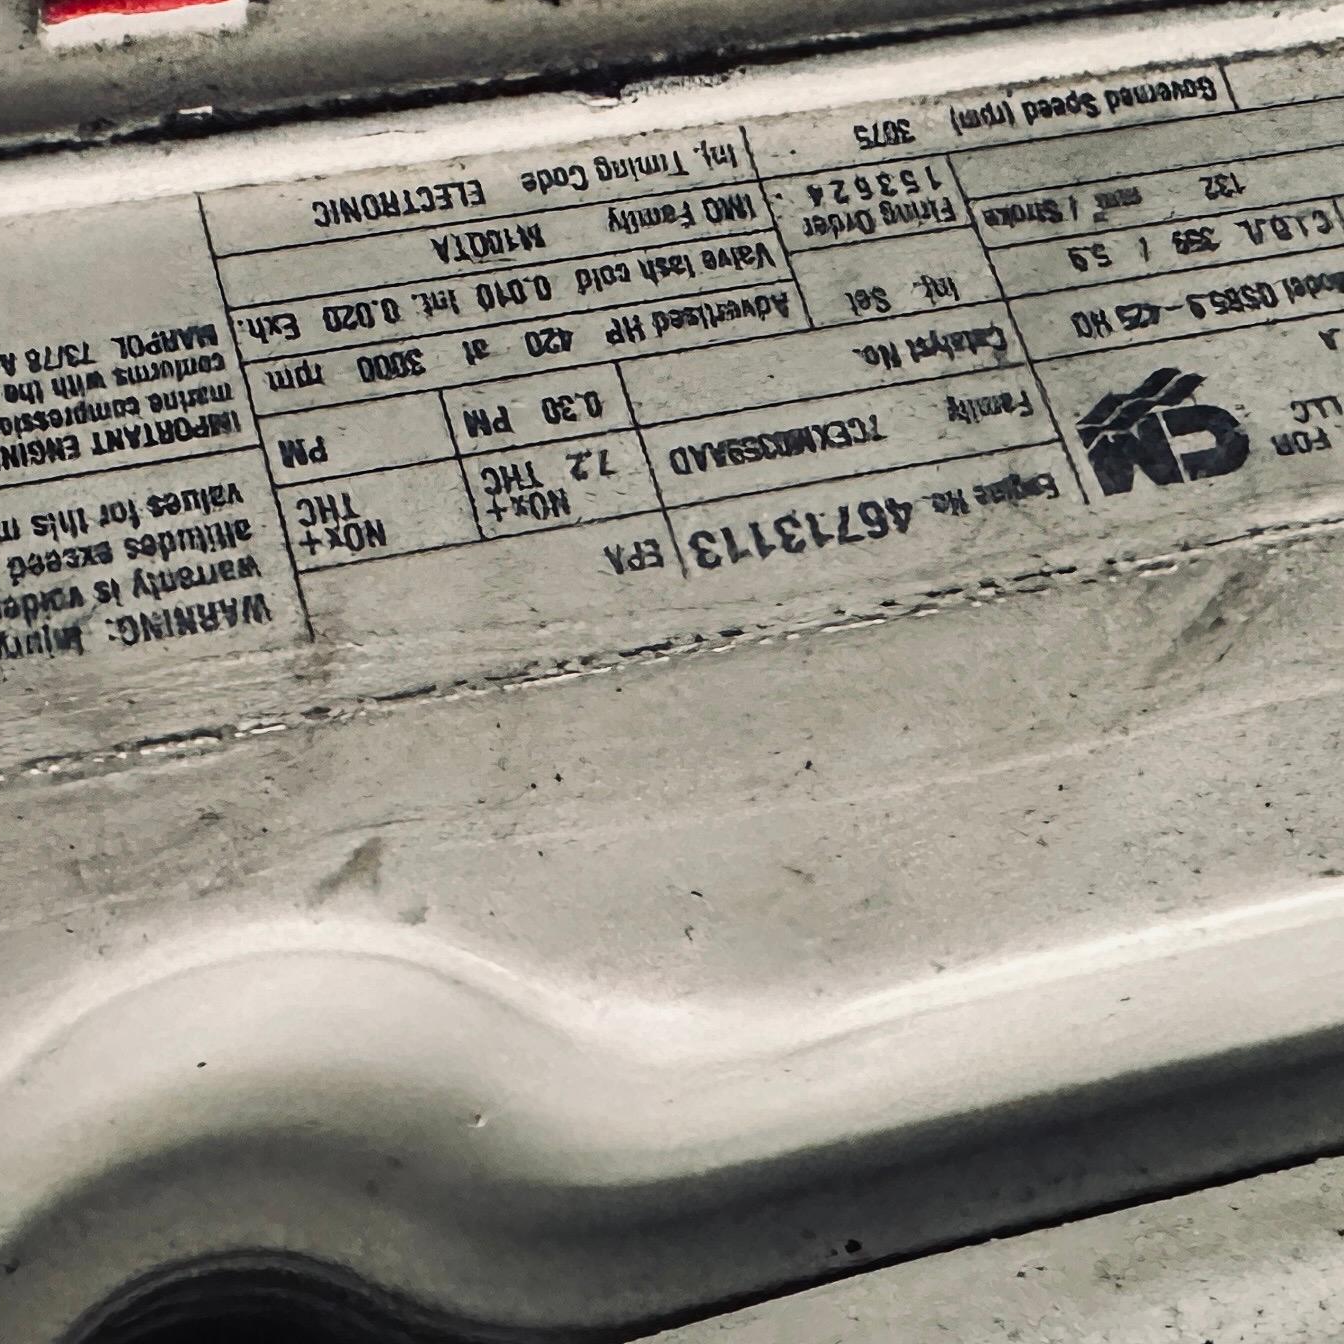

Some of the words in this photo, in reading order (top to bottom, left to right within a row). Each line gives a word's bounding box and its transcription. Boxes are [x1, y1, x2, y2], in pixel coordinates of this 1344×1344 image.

[1022, 91, 1100, 125] Speed
[1105, 77, 1216, 113] Governed
[951, 102, 1014, 135] (rpm)
[855, 120, 915, 149] 3075
[595, 152, 688, 181] Timing
[694, 141, 737, 169] Inj.
[522, 166, 588, 194] Code
[1200, 173, 1245, 199] 132
[313, 181, 485, 226] ELECTRONIC
[609, 202, 695, 233] Family
[703, 195, 756, 222] IMO
[880, 198, 956, 225] Firing
[804, 210, 875, 237] Order
[639, 256, 694, 285] lash
[702, 243, 775, 269] Valve
[476, 276, 550, 311] 0.010
[576, 264, 630, 294] cold
[914, 276, 961, 307] Inj.
[324, 299, 400, 331] 0.020
[412, 291, 459, 317] Int.
[653, 293, 788, 337] Advertised
[846, 288, 890, 318] Set
[112, 325, 217, 358] MARPOL
[238, 314, 300, 343] Exh.
[525, 329, 572, 356] 420
[607, 316, 645, 345] HP
[906, 323, 1007, 362] Catalyst
[26, 343, 96, 372] 73/78
[358, 349, 425, 382] 3000
[463, 340, 489, 364] at
[853, 343, 901, 369] No.
[113, 353, 225, 385] conforms
[266, 360, 324, 391] rpm
[4, 381, 43, 403] the
[52, 372, 106, 398] with
[147, 384, 233, 412] marine
[464, 407, 513, 437] PM
[544, 392, 602, 423] 0.30
[945, 391, 1033, 423] Family
[1291, 397, 1342, 423] LLC
[92, 411, 240, 454] IMPORTANT
[1272, 428, 1331, 455] FOR
[279, 437, 327, 467] PM
[1078, 406, 1249, 495] CM
[481, 462, 543, 494] THC
[100, 500, 139, 528] for
[147, 484, 243, 517] values
[297, 494, 359, 526] THC
[32, 509, 88, 541] this
[125, 520, 252, 560] altitudes
[689, 499, 912, 568] 46713113
[8, 542, 112, 585] exceed
[605, 540, 663, 574] EPA
[134, 556, 261, 599] warranty
[95, 580, 122, 606] is
[106, 594, 271, 645] WARNING:
